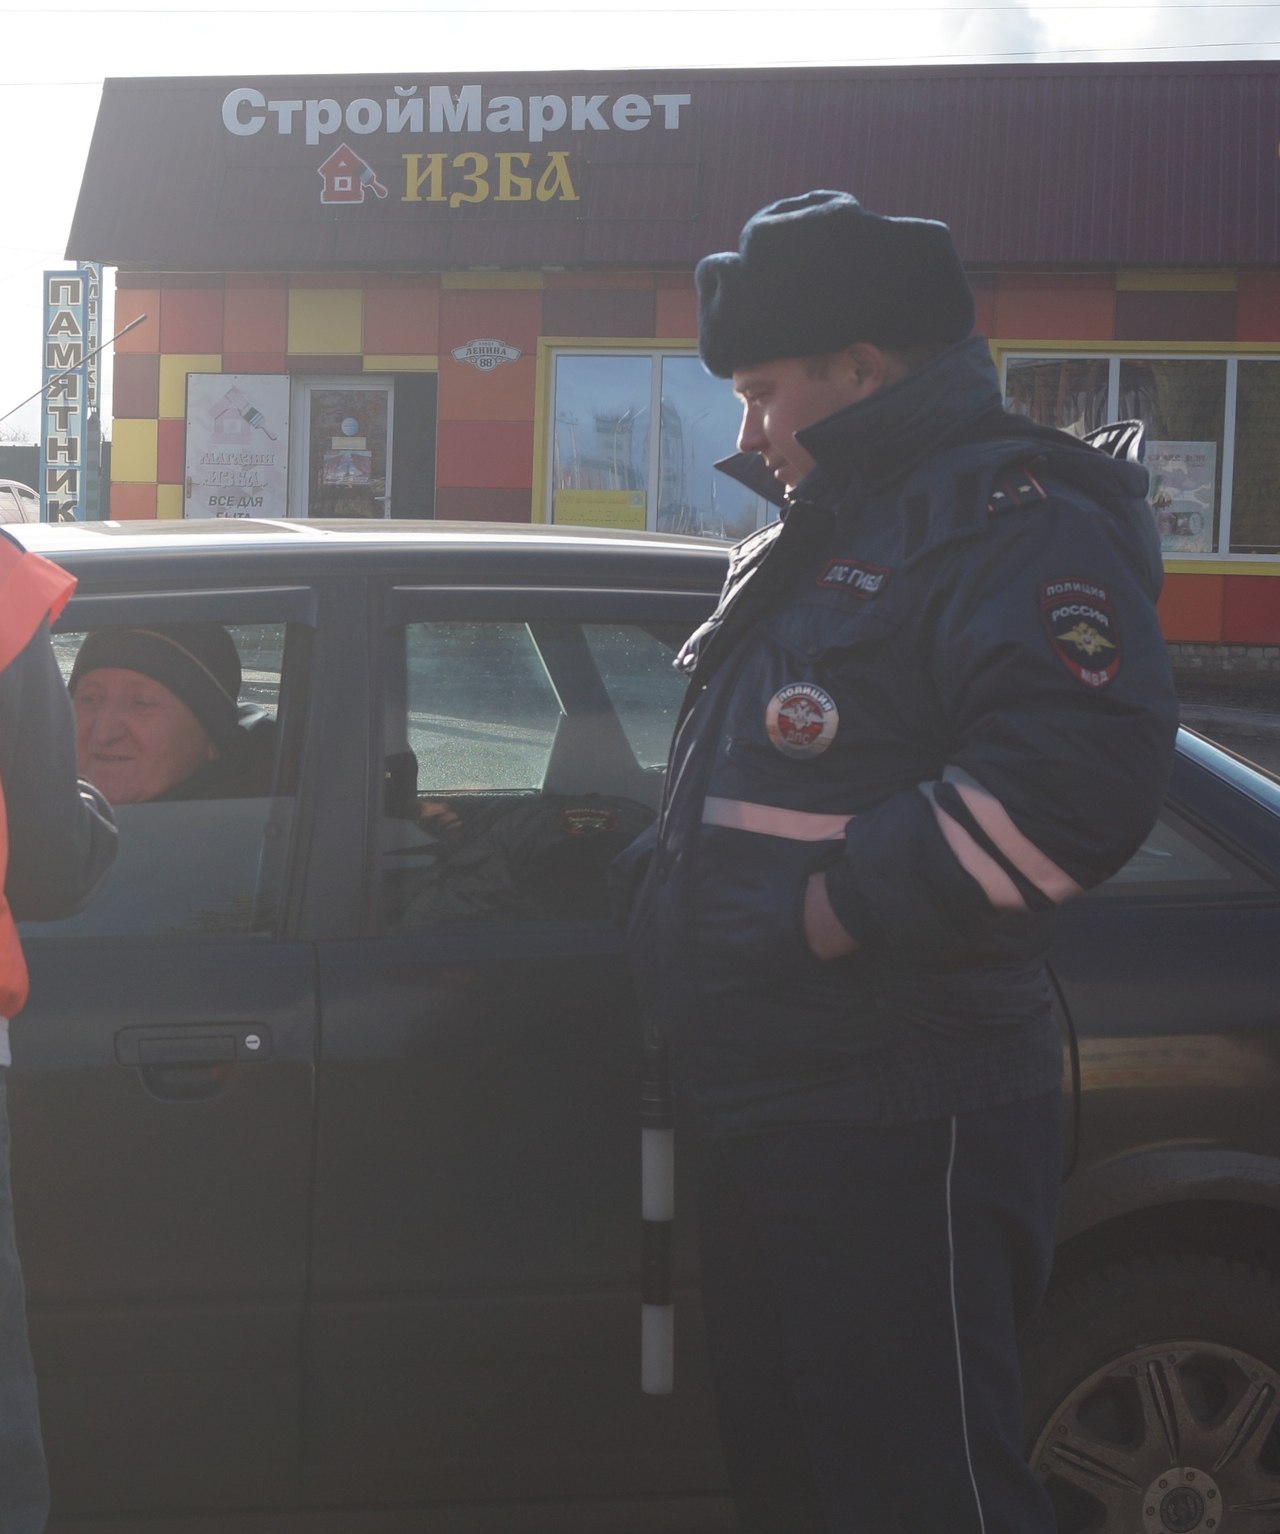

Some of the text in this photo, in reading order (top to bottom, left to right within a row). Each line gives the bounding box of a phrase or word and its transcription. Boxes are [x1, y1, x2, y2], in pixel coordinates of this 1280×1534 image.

[221, 84, 692, 145] СтройМаркет
[401, 151, 580, 208] ИЗБА
[466, 346, 507, 356] ЛЕНИНА
[479, 358, 493, 368] 88
[45, 278, 82, 522] ПАМЯТНИК
[208, 495, 264, 508] ВСЕ ДЛЯ
[1046, 582, 1106, 600] ПОЛИЦИЯ
[1051, 604, 1109, 627] РОССИЯ
[1081, 668, 1109, 686] МВД
[778, 686, 835, 714] ПОЛИЦИЯ
[786, 731, 810, 745] ДПС
